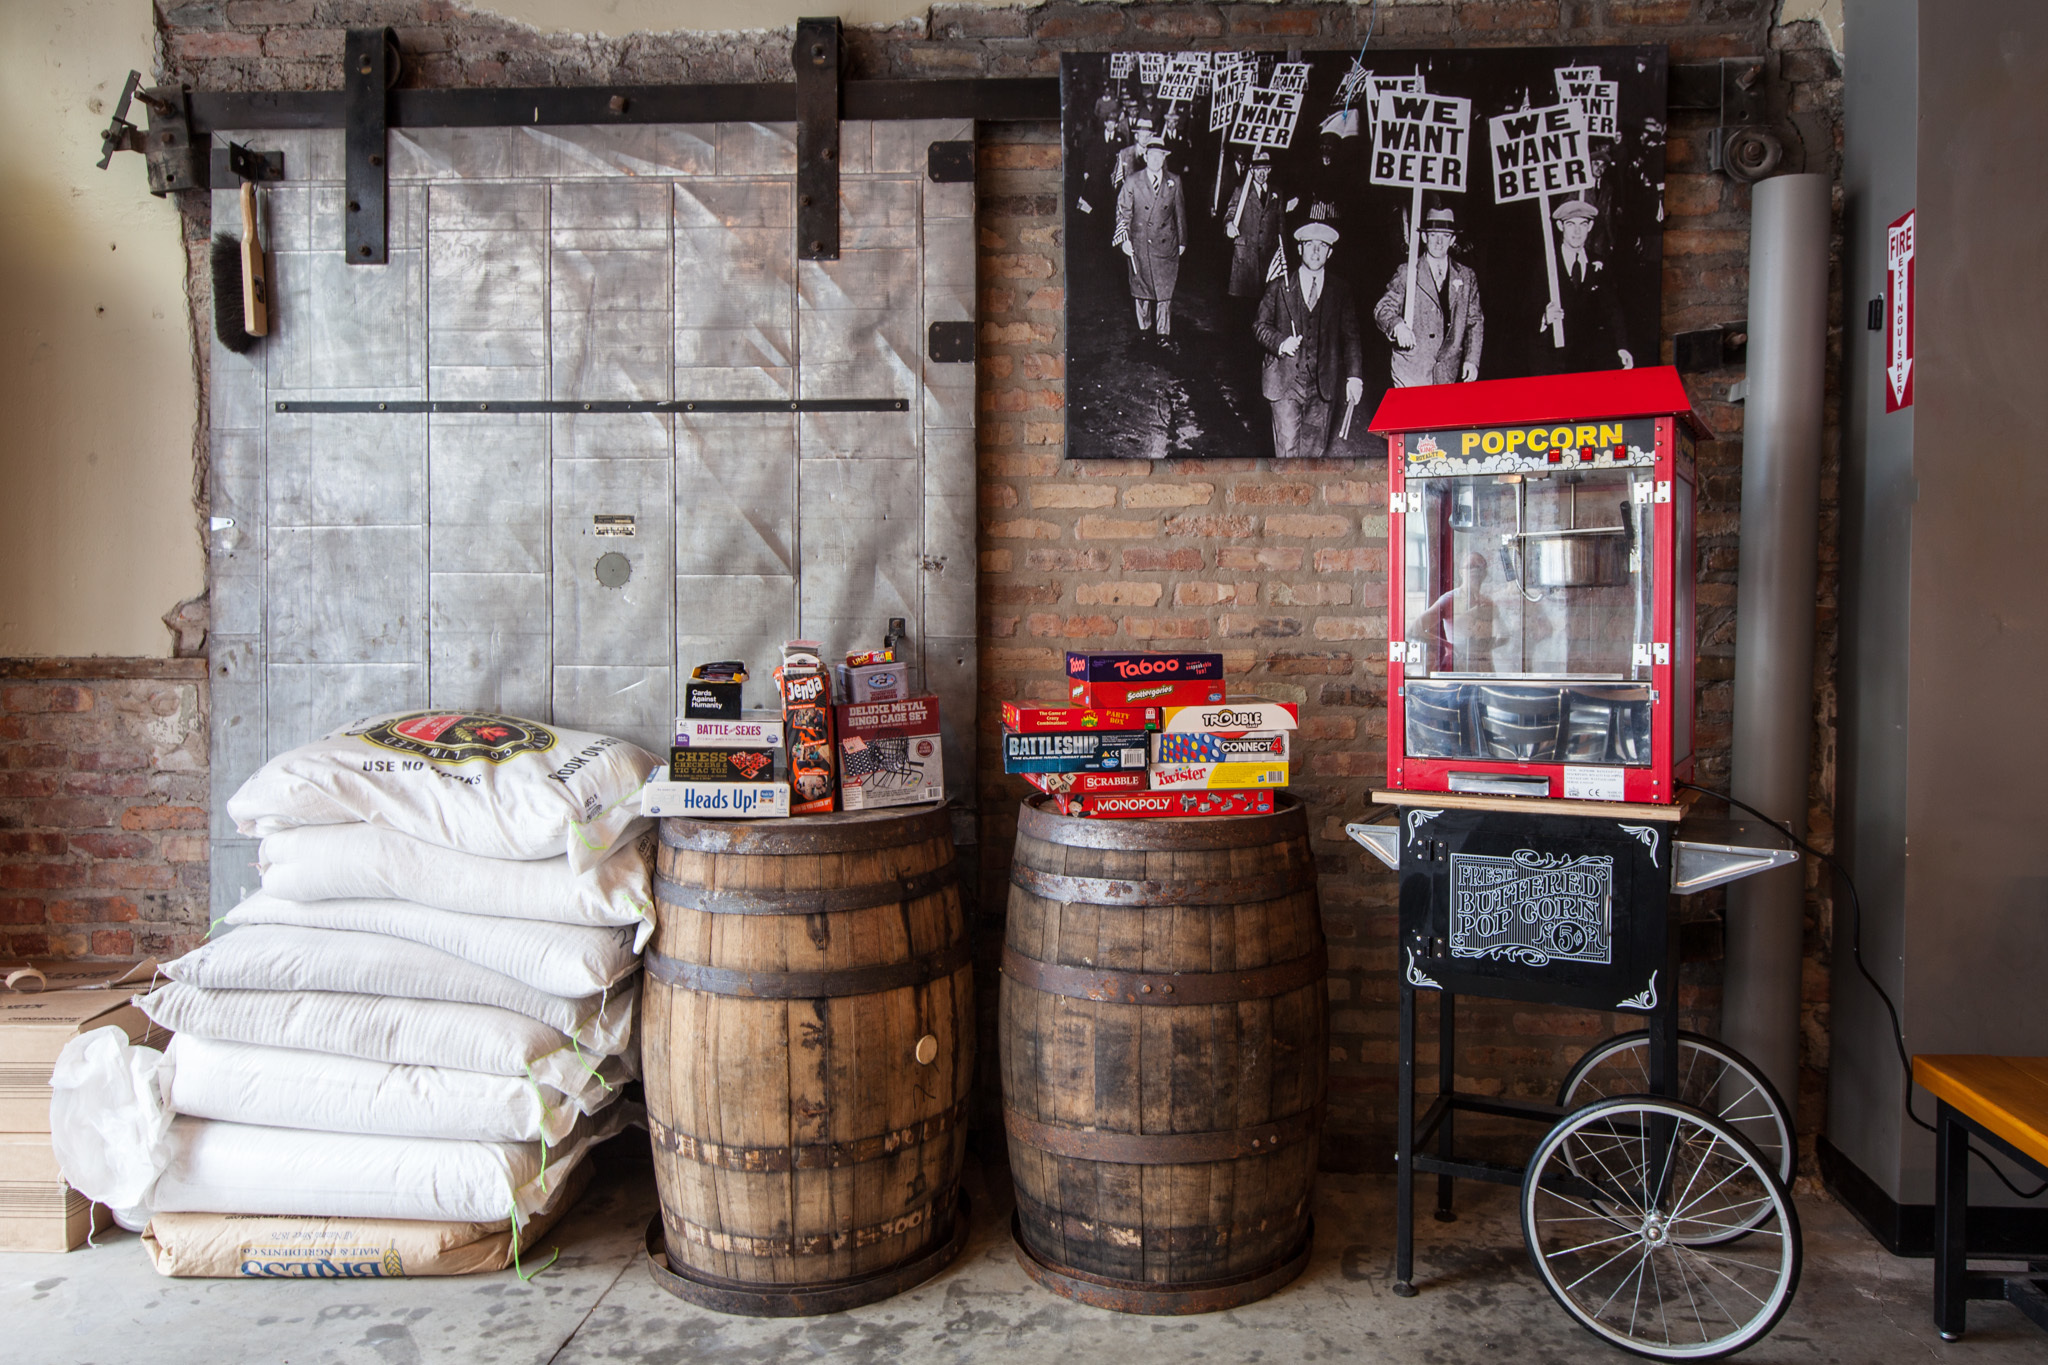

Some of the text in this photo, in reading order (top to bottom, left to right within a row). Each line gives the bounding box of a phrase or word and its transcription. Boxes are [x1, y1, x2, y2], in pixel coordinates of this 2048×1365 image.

[1172, 62, 1198, 74] WE
[1280, 65, 1305, 75] WE
[1165, 72, 1198, 86] WANT
[1217, 66, 1239, 88] WE
[1273, 75, 1305, 88] WANT
[1160, 85, 1193, 99] BEER
[1214, 82, 1241, 109] WANT
[1569, 83, 1610, 97] WE
[1252, 89, 1295, 109] WE
[1240, 104, 1297, 128] WANT
[1392, 95, 1458, 125] WE
[1502, 108, 1572, 140] WE
[1233, 122, 1290, 145] BEER
[1381, 120, 1465, 155] WANT
[1496, 130, 1581, 170] WANT
[1375, 151, 1462, 187] BEER
[1499, 159, 1587, 199] BEER
[1890, 226, 1912, 261] FIRE
[1896, 257, 1904, 395] EXTINGUISHER
[1461, 423, 1624, 455] POPCORN
[852, 653, 869, 665] UNO
[1069, 657, 1086, 674] Taboo
[1113, 658, 1179, 679] Taboo
[787, 676, 823, 701] Jenga
[1126, 685, 1173, 702] Scattergories
[691, 702, 722, 710] Humanity
[692, 695, 717, 703] Against
[849, 701, 926, 716] DELUXE METAL
[1106, 710, 1130, 720] PARTY
[848, 715, 879, 727] BINGO
[880, 713, 907, 724] CAGE
[909, 710, 928, 720] SET
[1110, 717, 1125, 725] BOX
[1203, 711, 1262, 727] TROUBLE
[696, 724, 729, 735] BATTLE
[735, 725, 762, 736] SEXES
[1009, 735, 1099, 756] BATTLESHIP
[1221, 737, 1283, 754] CONNECT 4
[675, 752, 728, 762] CHESS
[362, 760, 395, 772] USE
[402, 760, 424, 772] NO
[1086, 776, 1139, 788] SCRABBLE
[1155, 768, 1207, 786] Twister
[684, 788, 758, 813] Heads Up!
[1097, 798, 1171, 812] MONOPOLY
[1457, 865, 1518, 886] FRESH
[1457, 871, 1601, 914] BUTTERED
[1458, 897, 1601, 937] POP CORN
[271, 1232, 290, 1240] 1876
[260, 1247, 337, 1257] INGREDIENTS
[340, 1247, 349, 1256] &
[351, 1247, 380, 1256] MALT
